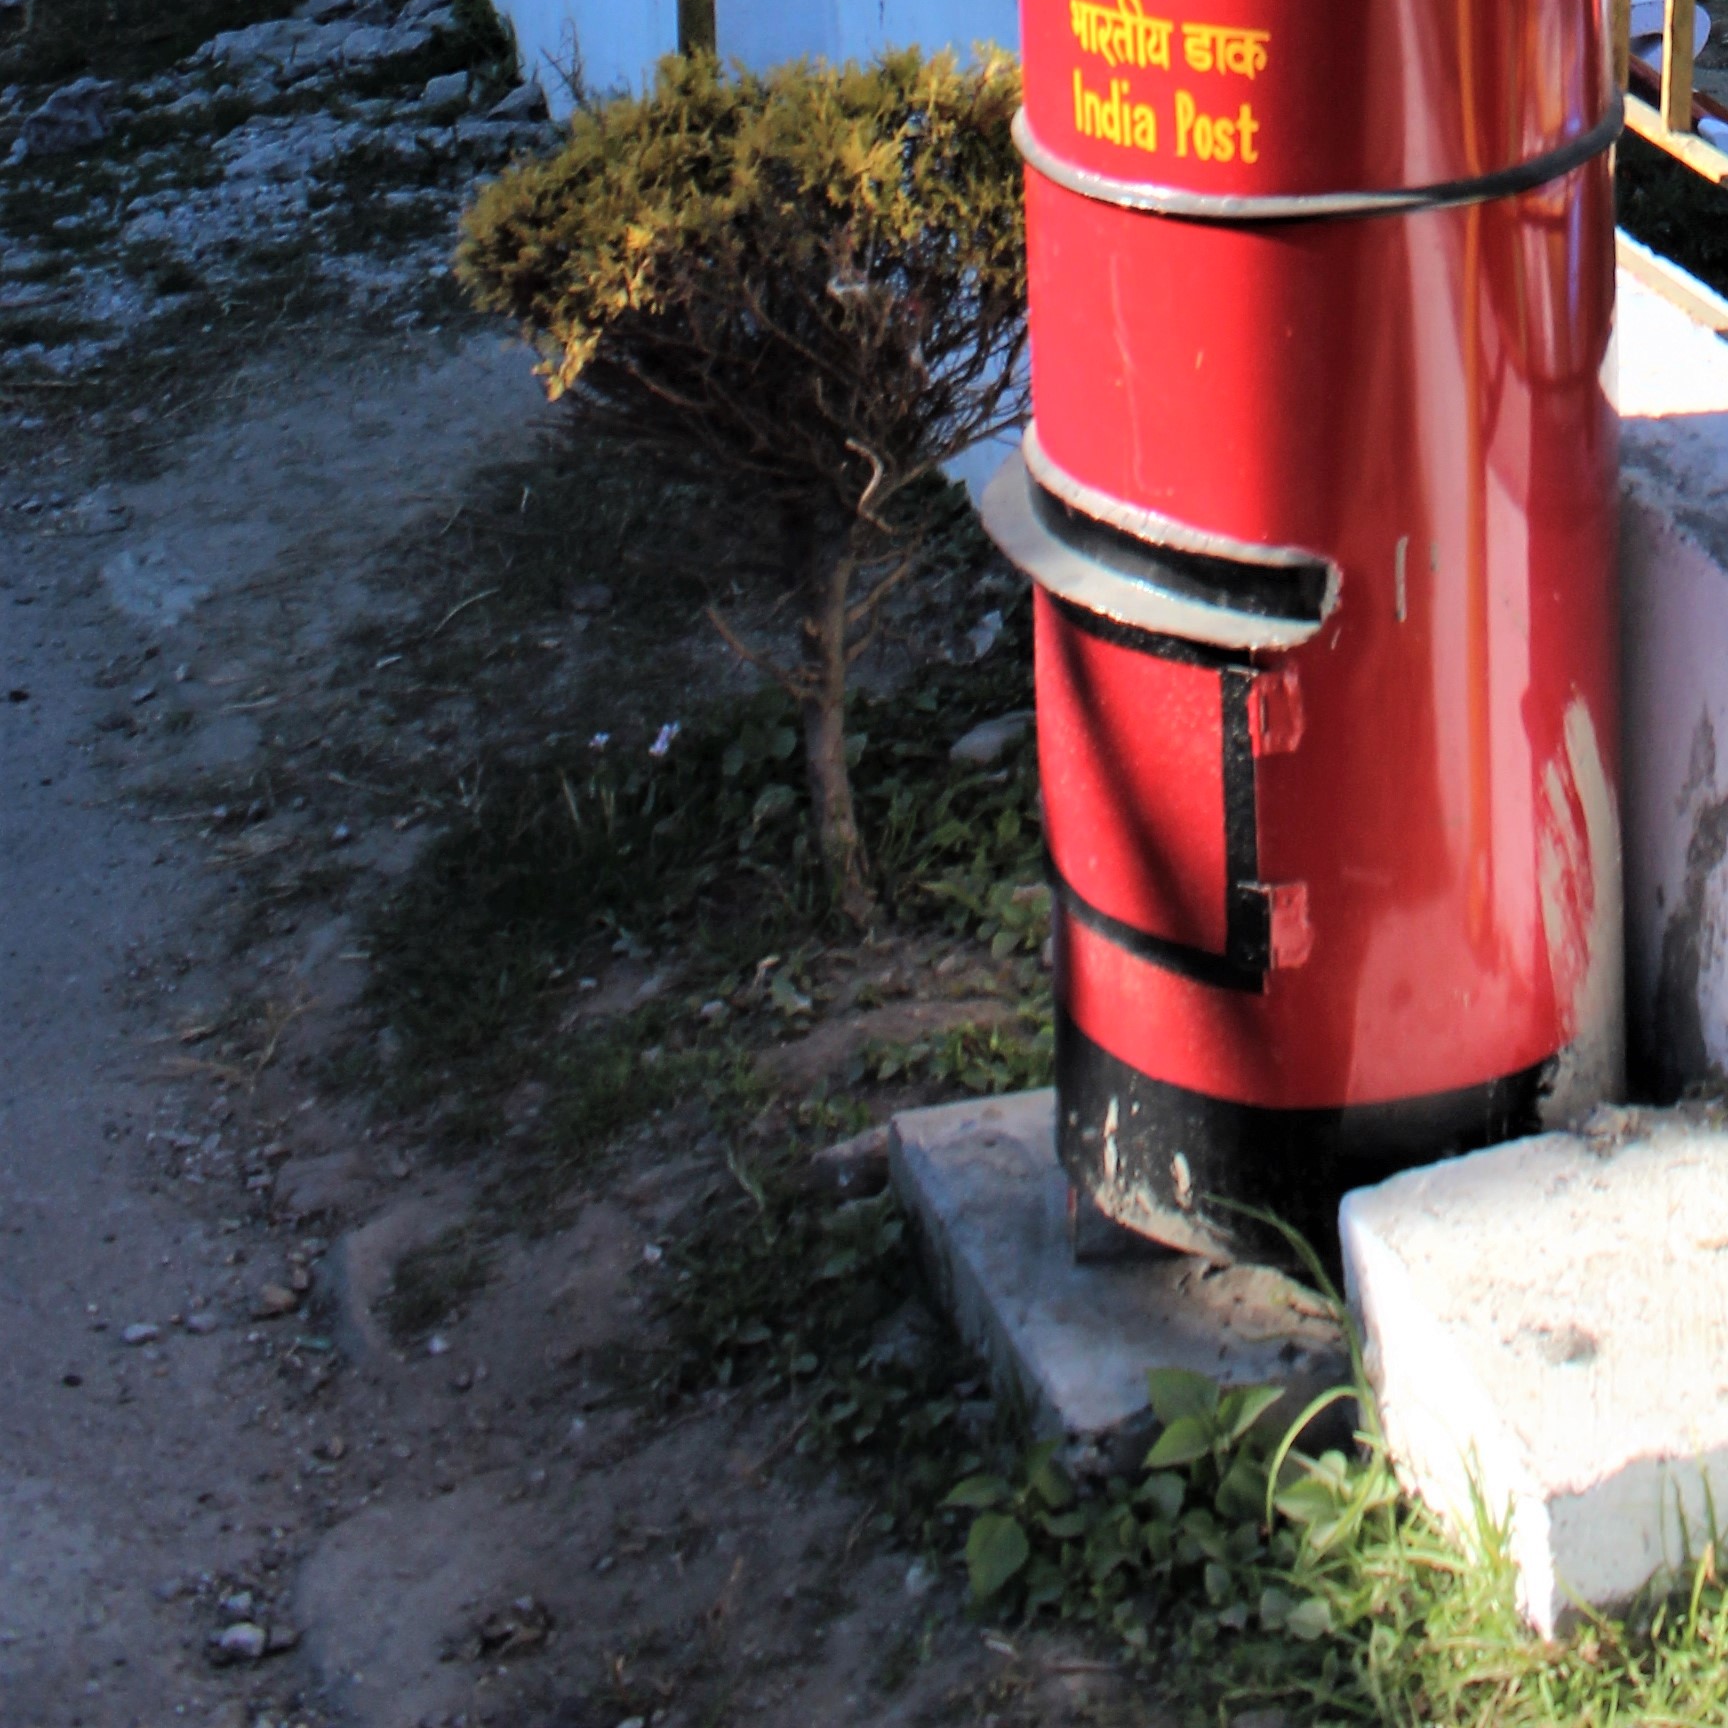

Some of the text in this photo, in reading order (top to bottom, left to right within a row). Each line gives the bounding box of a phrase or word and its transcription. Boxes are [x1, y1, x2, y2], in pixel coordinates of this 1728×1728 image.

[1181, 21, 1271, 80] डाक
[1073, 66, 1259, 164] India Post
